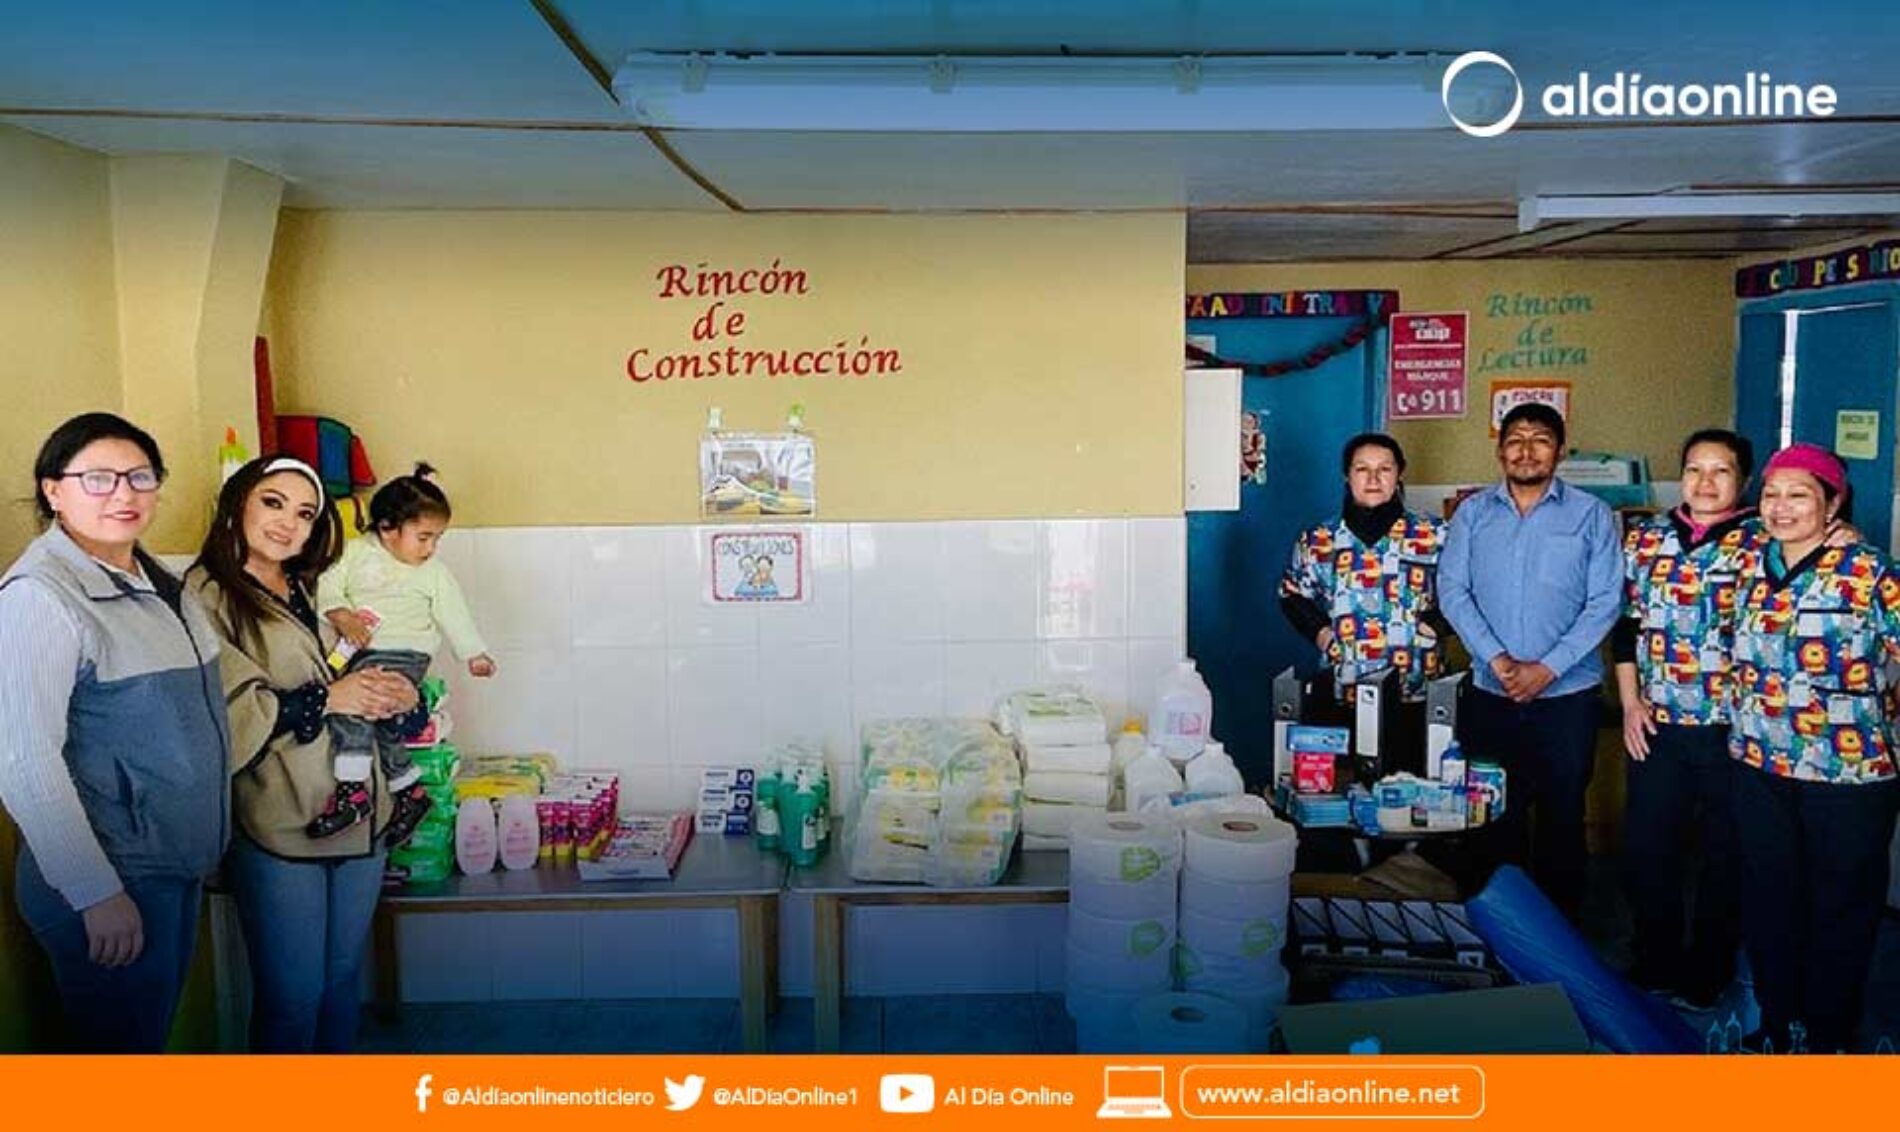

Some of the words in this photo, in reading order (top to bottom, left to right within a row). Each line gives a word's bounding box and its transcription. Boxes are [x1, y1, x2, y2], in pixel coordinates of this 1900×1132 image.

[656, 258, 810, 298] Rincón
[1486, 289, 1594, 318] Rincón
[692, 301, 746, 342] de
[1518, 318, 1554, 346] de
[627, 336, 904, 383] Construcción
[1478, 345, 1587, 373] Lectura
[1420, 389, 1462, 411] 911
